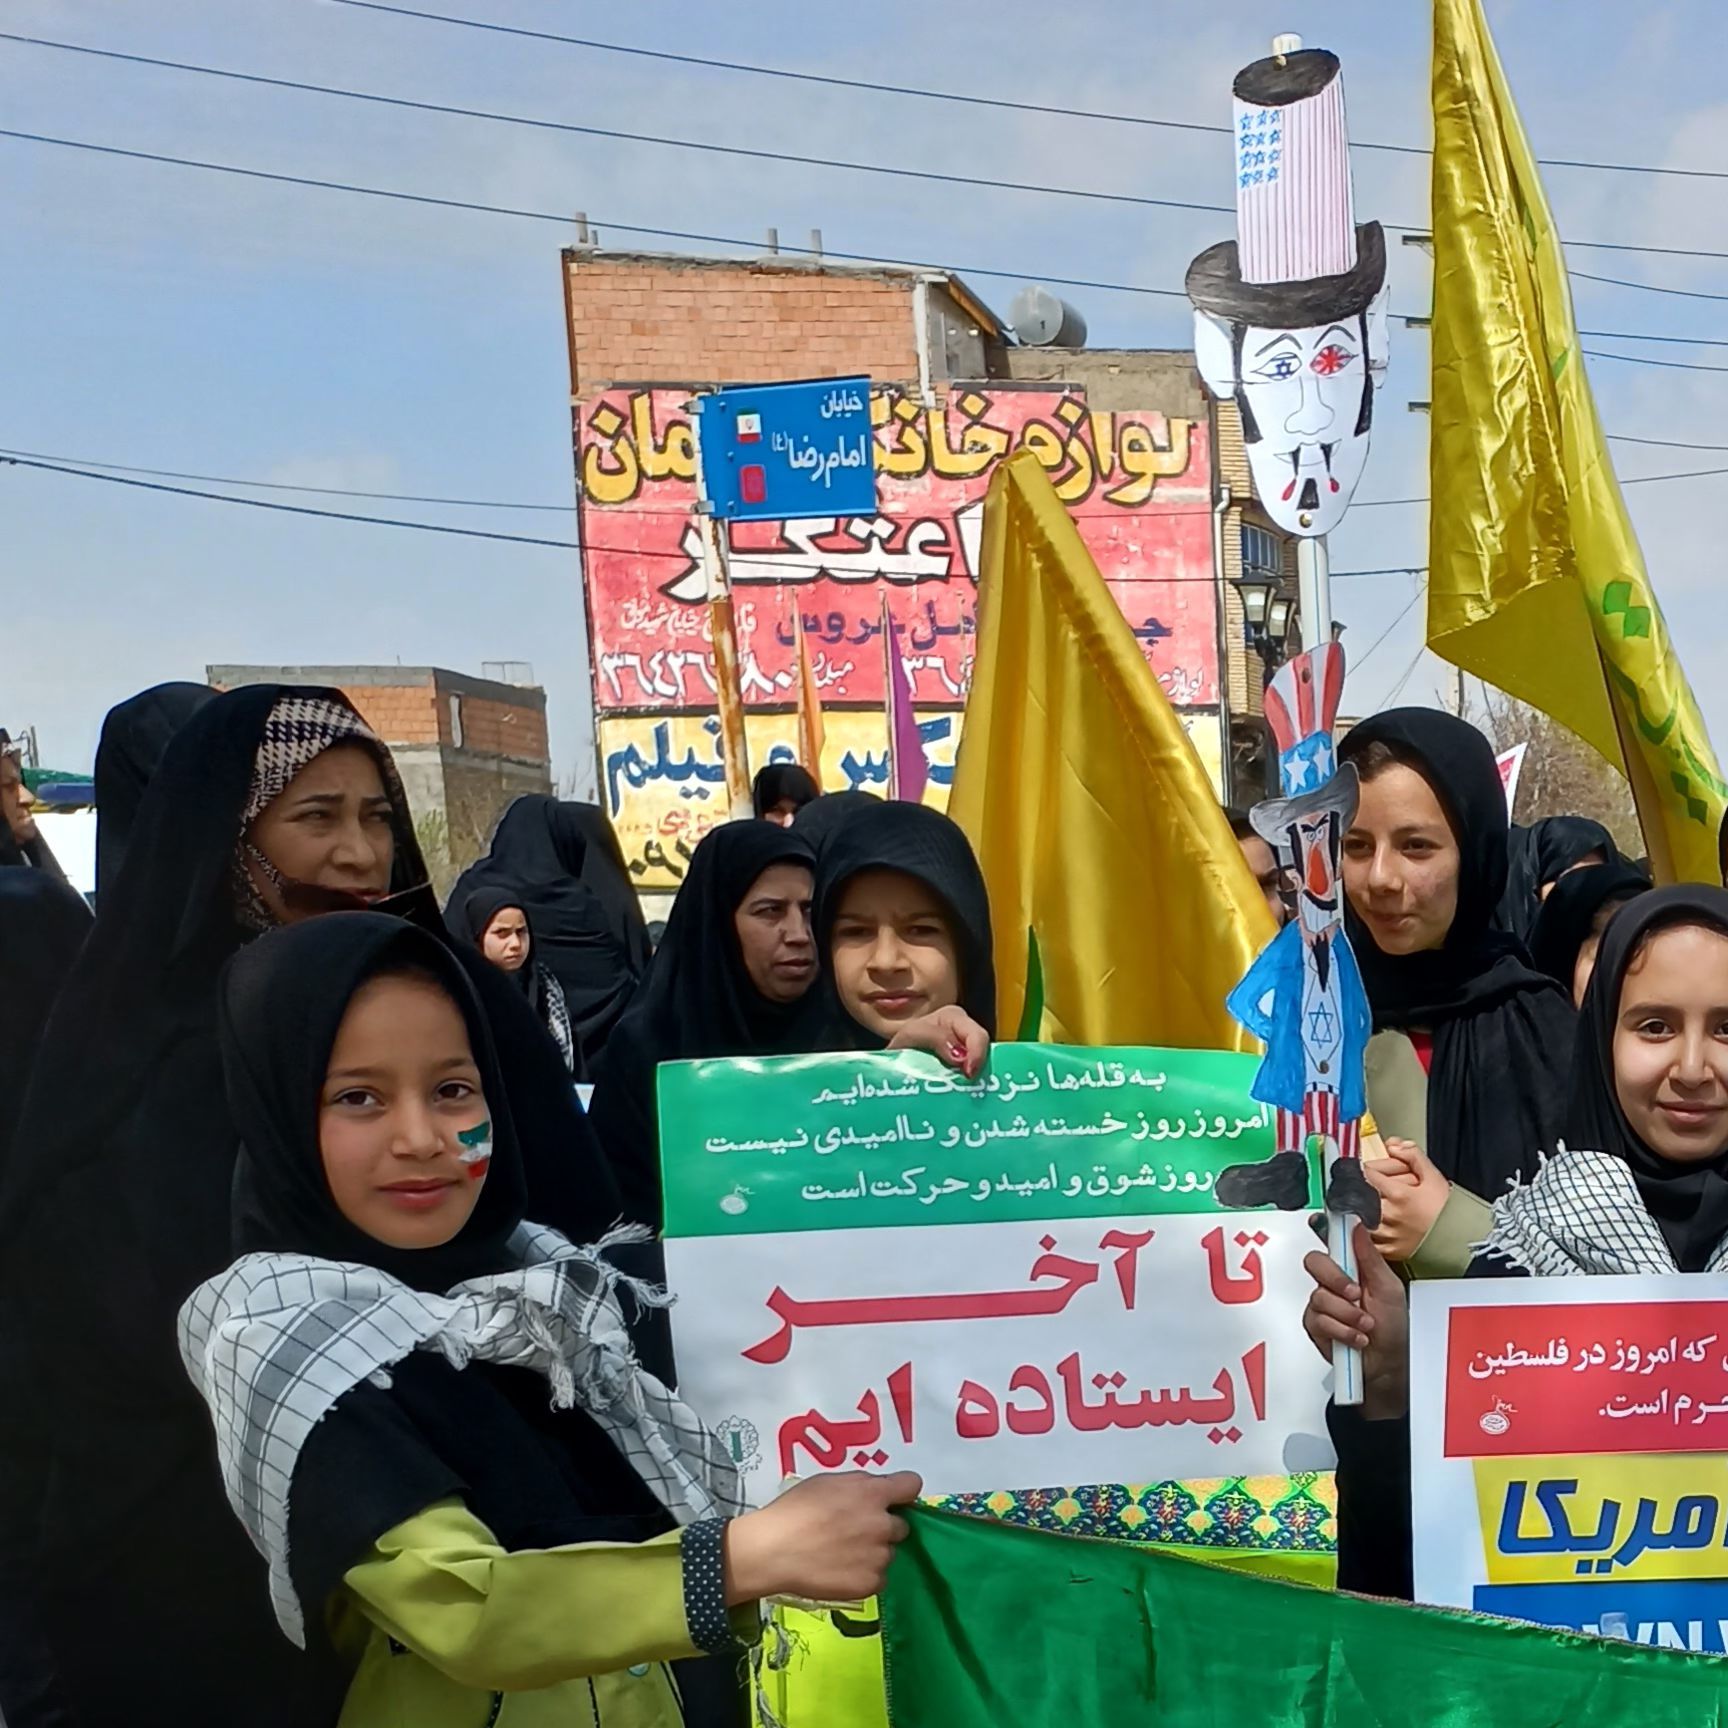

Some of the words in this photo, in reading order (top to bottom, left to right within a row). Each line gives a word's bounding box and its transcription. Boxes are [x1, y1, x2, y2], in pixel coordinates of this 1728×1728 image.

[820, 389, 863, 419] خیابان
[873, 390, 1013, 482] خان
[788, 435, 825, 482] رضا
[824, 434, 867, 489] امام
[923, 1072, 1040, 1102] نزدیک
[1129, 1067, 1168, 1089] به
[813, 1113, 935, 1155] ناامیدی
[939, 1122, 960, 1148] و
[964, 1114, 1031, 1149] شدن
[1033, 1111, 1128, 1137] خسته
[1130, 1111, 1186, 1141] روز
[1188, 1102, 1269, 1141] امروز
[705, 1127, 810, 1155] نیست
[801, 1170, 868, 1201] است
[869, 1166, 971, 1205] حرکت
[970, 1178, 993, 1201] و
[995, 1162, 1059, 1197] امید
[1062, 1173, 1083, 1197] و
[1086, 1163, 1158, 1196] شوق
[1158, 1164, 1214, 1192] روز
[1200, 1225, 1271, 1305] تا
[741, 1228, 1156, 1366] آخر
[1468, 1337, 1571, 1380] فلسطین
[1572, 1342, 1607, 1372] در
[1609, 1336, 1678, 1375] امروز
[1681, 1331, 1719, 1363] که
[955, 1341, 1268, 1446] ایستاده
[1598, 1388, 1669, 1419] است.
[777, 1360, 914, 1477] ایم
